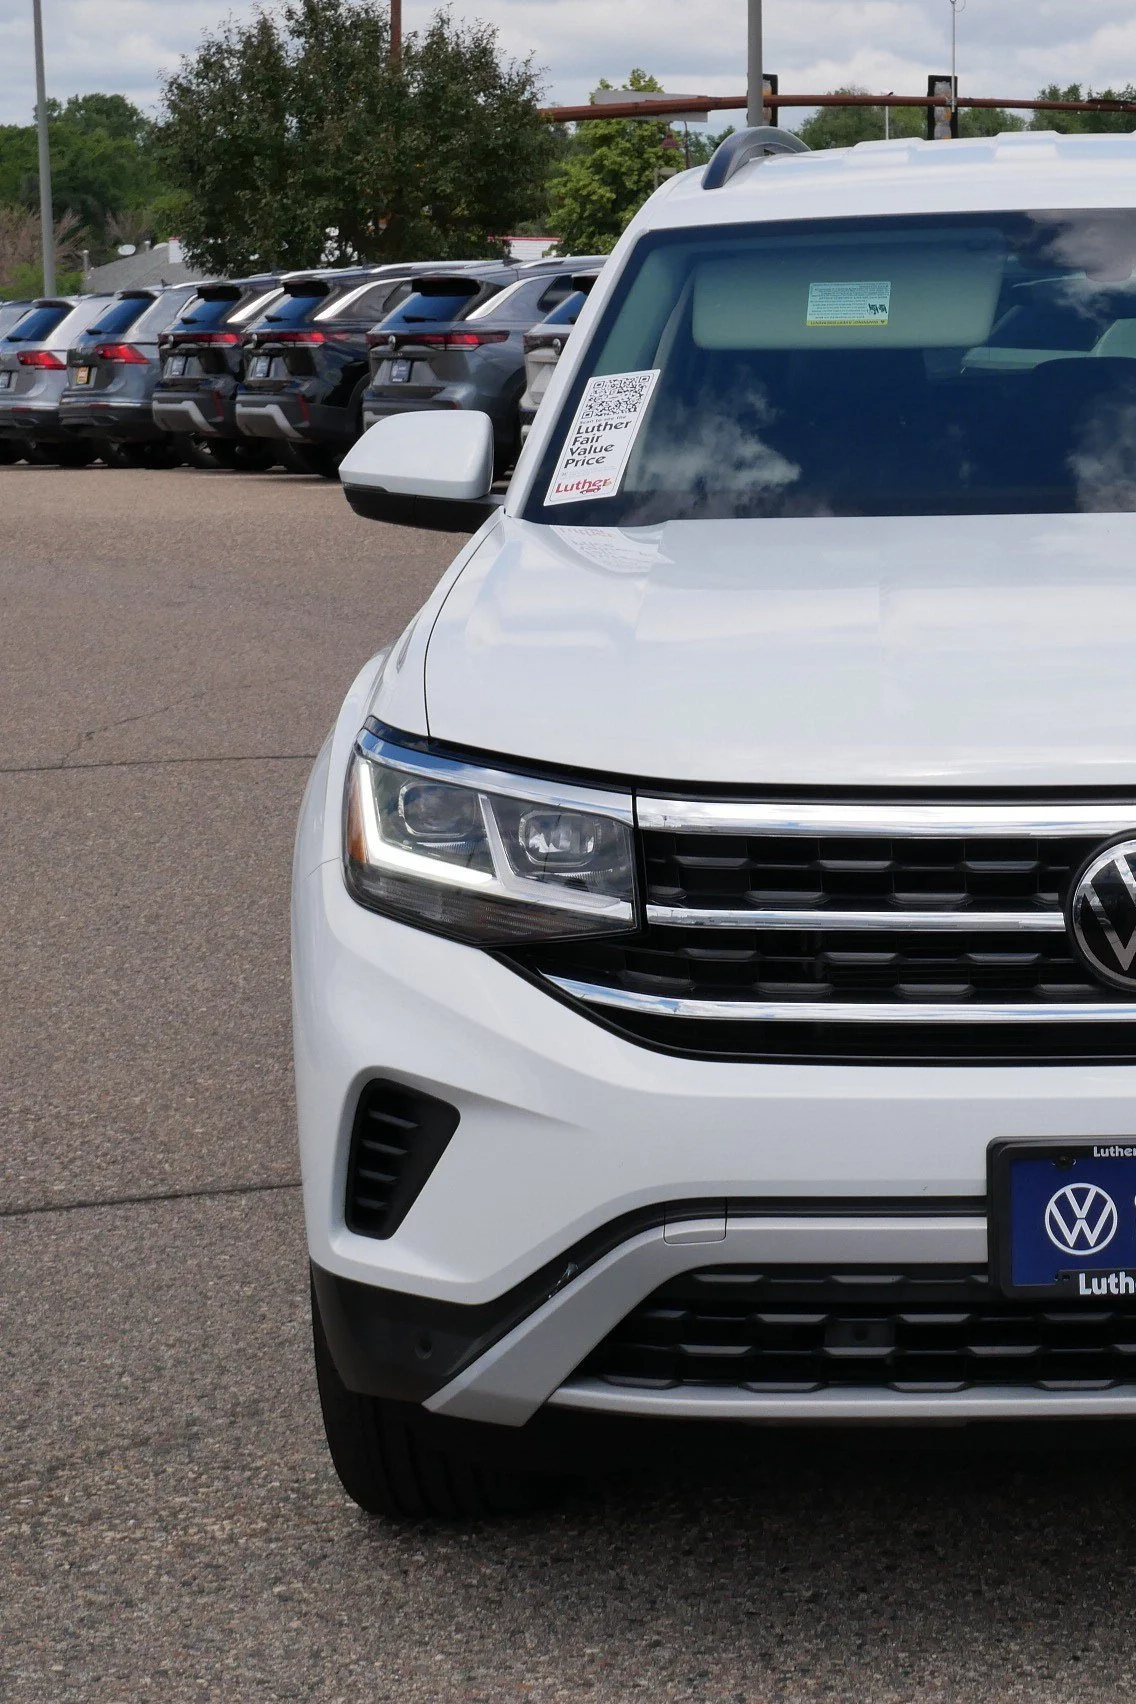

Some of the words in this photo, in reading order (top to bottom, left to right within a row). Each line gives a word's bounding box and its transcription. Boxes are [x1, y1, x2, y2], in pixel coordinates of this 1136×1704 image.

[576, 420, 632, 435] Luther
[571, 433, 603, 447] Fair
[569, 443, 615, 457] Value
[563, 455, 607, 469] Price
[555, 477, 611, 494] Luther
